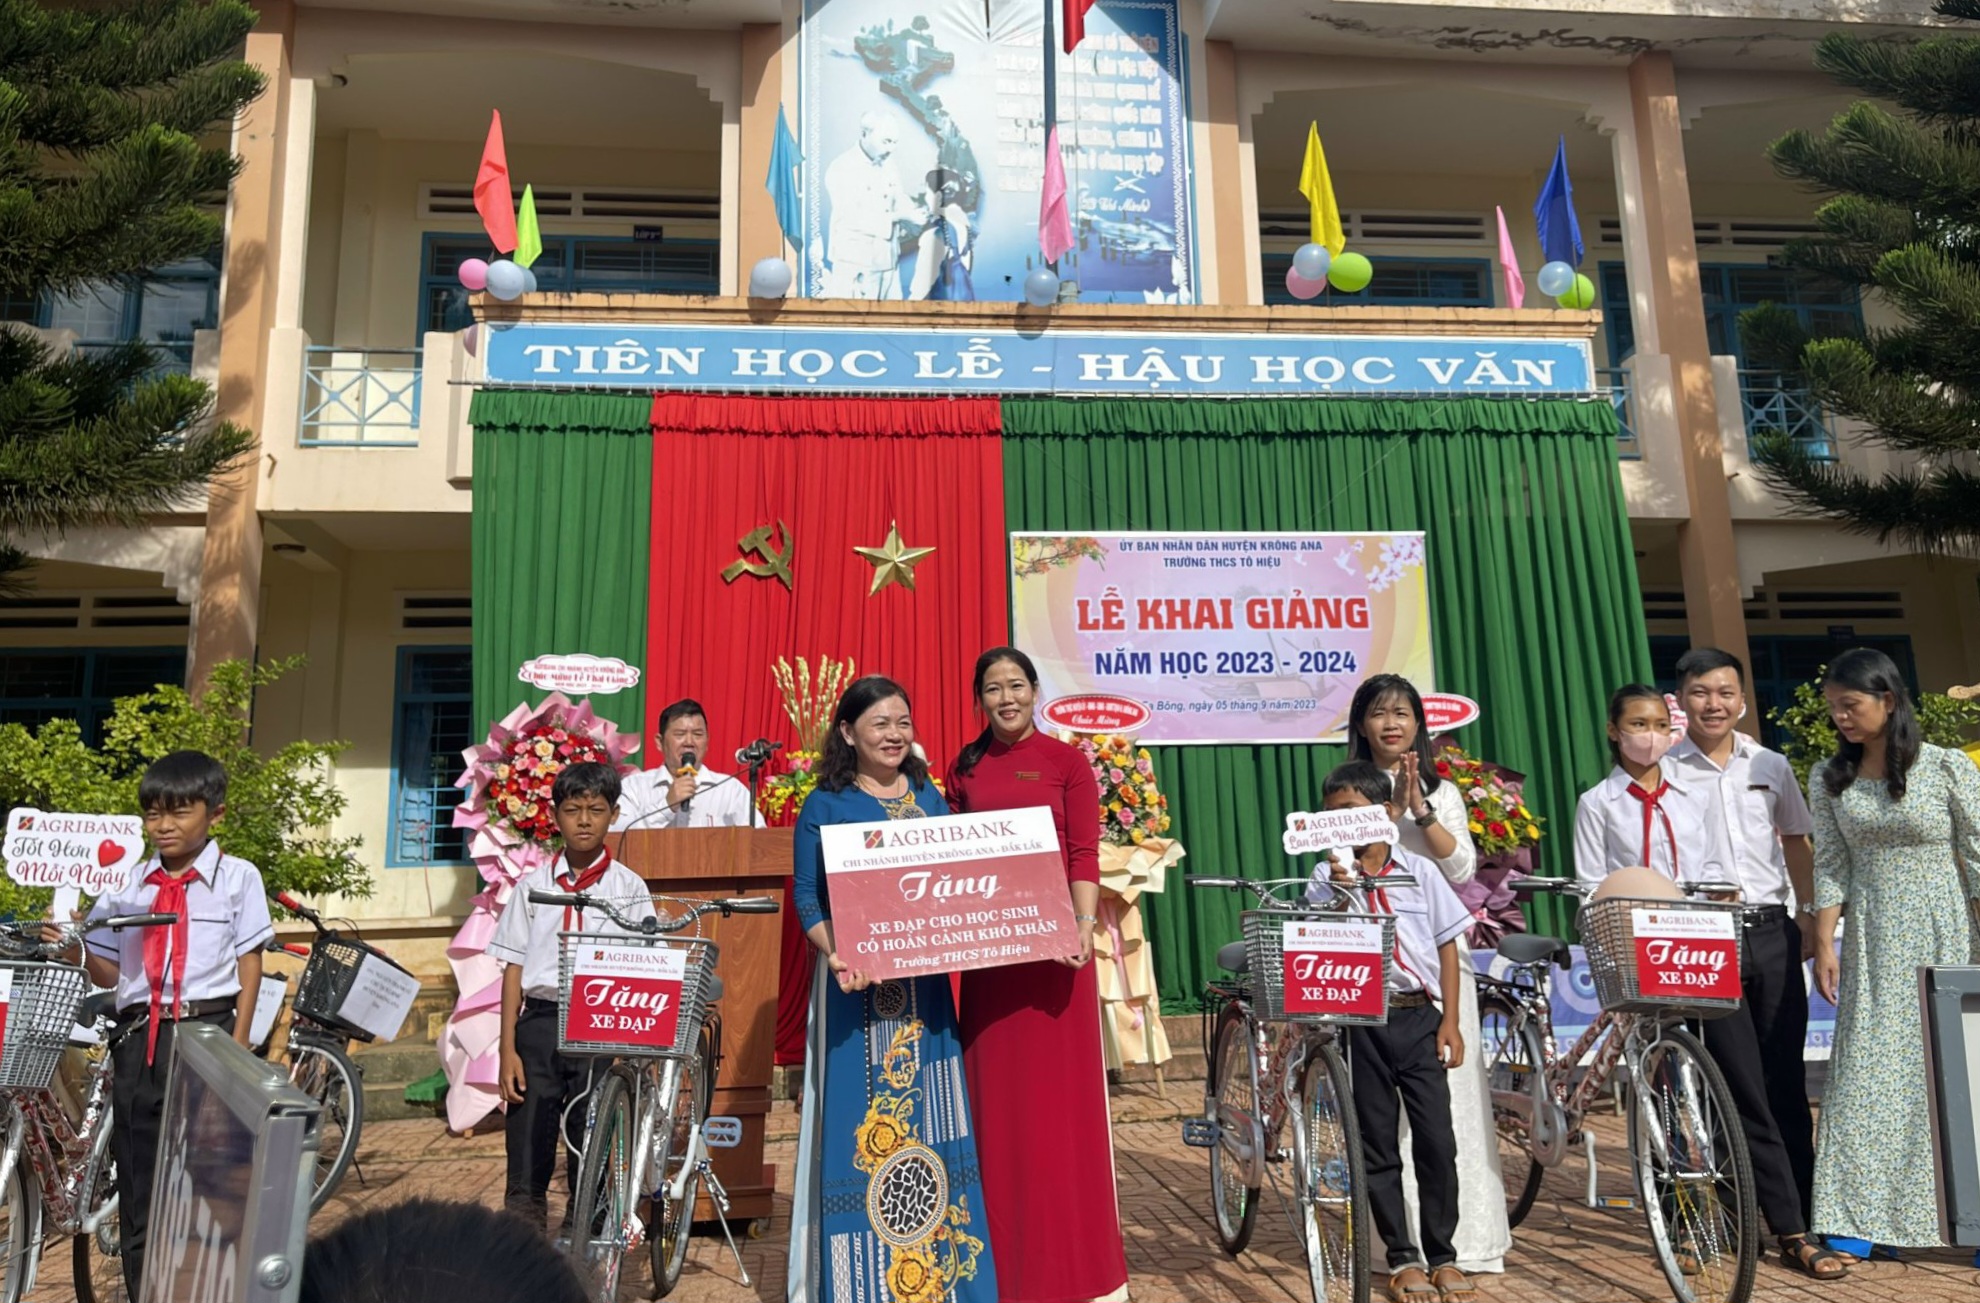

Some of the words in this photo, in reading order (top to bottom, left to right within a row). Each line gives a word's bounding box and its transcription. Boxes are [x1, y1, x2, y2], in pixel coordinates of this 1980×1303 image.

[523, 339, 705, 375] TIÊN
[731, 347, 887, 383] HỌC
[914, 337, 1003, 379] LỄ
[1078, 347, 1224, 389] HẬU
[1250, 355, 1397, 390] HỌC
[1416, 351, 1557, 387] VĂN
[1137, 541, 1159, 551] BAN
[1162, 540, 1193, 551] NHÂN
[1196, 540, 1218, 551] DÂN
[1221, 540, 1257, 554] HUYỆN
[1260, 539, 1297, 551] KRÔNG
[1300, 541, 1323, 551] ANA
[1163, 556, 1207, 568] TRƯỜNG
[1209, 557, 1237, 568] THCS
[1240, 556, 1252, 568] TÔ
[1256, 557, 1281, 570] HIỆU
[1076, 586, 1126, 632] LỄ
[1137, 597, 1234, 631] KHAI
[1245, 589, 1371, 631] GIẢNG
[1095, 647, 1153, 676] NĂM
[1160, 651, 1206, 681] HỌC
[1216, 651, 1275, 674] 2023
[1299, 651, 1357, 674] 2024
[1189, 700, 1213, 712] ngày
[1215, 700, 1228, 710] 05
[1230, 700, 1258, 712] tháng
[1260, 700, 1267, 710] 9
[1293, 700, 1316, 710] 2023
[36, 819, 137, 836] AGRIBANK
[1309, 811, 1383, 830] AGRIBANK
[889, 820, 1017, 848] AGRIBANK
[47, 838, 91, 859] Hơn
[843, 859, 862, 868] CHI
[863, 855, 899, 866] NHÁNH
[902, 851, 936, 863] HUYỆN
[938, 847, 973, 859] KRÔNG
[975, 847, 995, 856] ANA
[16, 861, 64, 883] Mỗi
[69, 863, 126, 892] Ngày
[899, 871, 1002, 904] Tặng
[868, 922, 891, 935] XE
[893, 918, 926, 934] ĐẠP
[929, 914, 962, 928] CHO
[965, 910, 999, 926] HỌC
[1001, 905, 1039, 920] SINH
[1659, 916, 1718, 926] AGRIBANK
[856, 937, 879, 954] CÓ
[882, 934, 927, 951] HOÀN
[931, 928, 974, 946] CẢNH
[977, 923, 1012, 940] KHÓ
[1013, 919, 1058, 936] KHĂN
[1307, 928, 1365, 939] AGRIBANK
[605, 953, 669, 965] AGRIBANK
[893, 955, 940, 969] Trường
[943, 949, 979, 963] THCS
[982, 946, 998, 958] Tô
[1001, 944, 1031, 957] Hiệu
[1646, 939, 1729, 971] Tặng
[1293, 953, 1373, 987] Tặng
[1658, 971, 1681, 985] XE
[1684, 972, 1719, 988] ĐẠP
[583, 978, 670, 1016] Tặng
[1301, 987, 1323, 1001] XE
[1326, 988, 1362, 1004] ĐẠP
[589, 1014, 615, 1029] XE
[618, 1016, 657, 1034] ĐẠP
